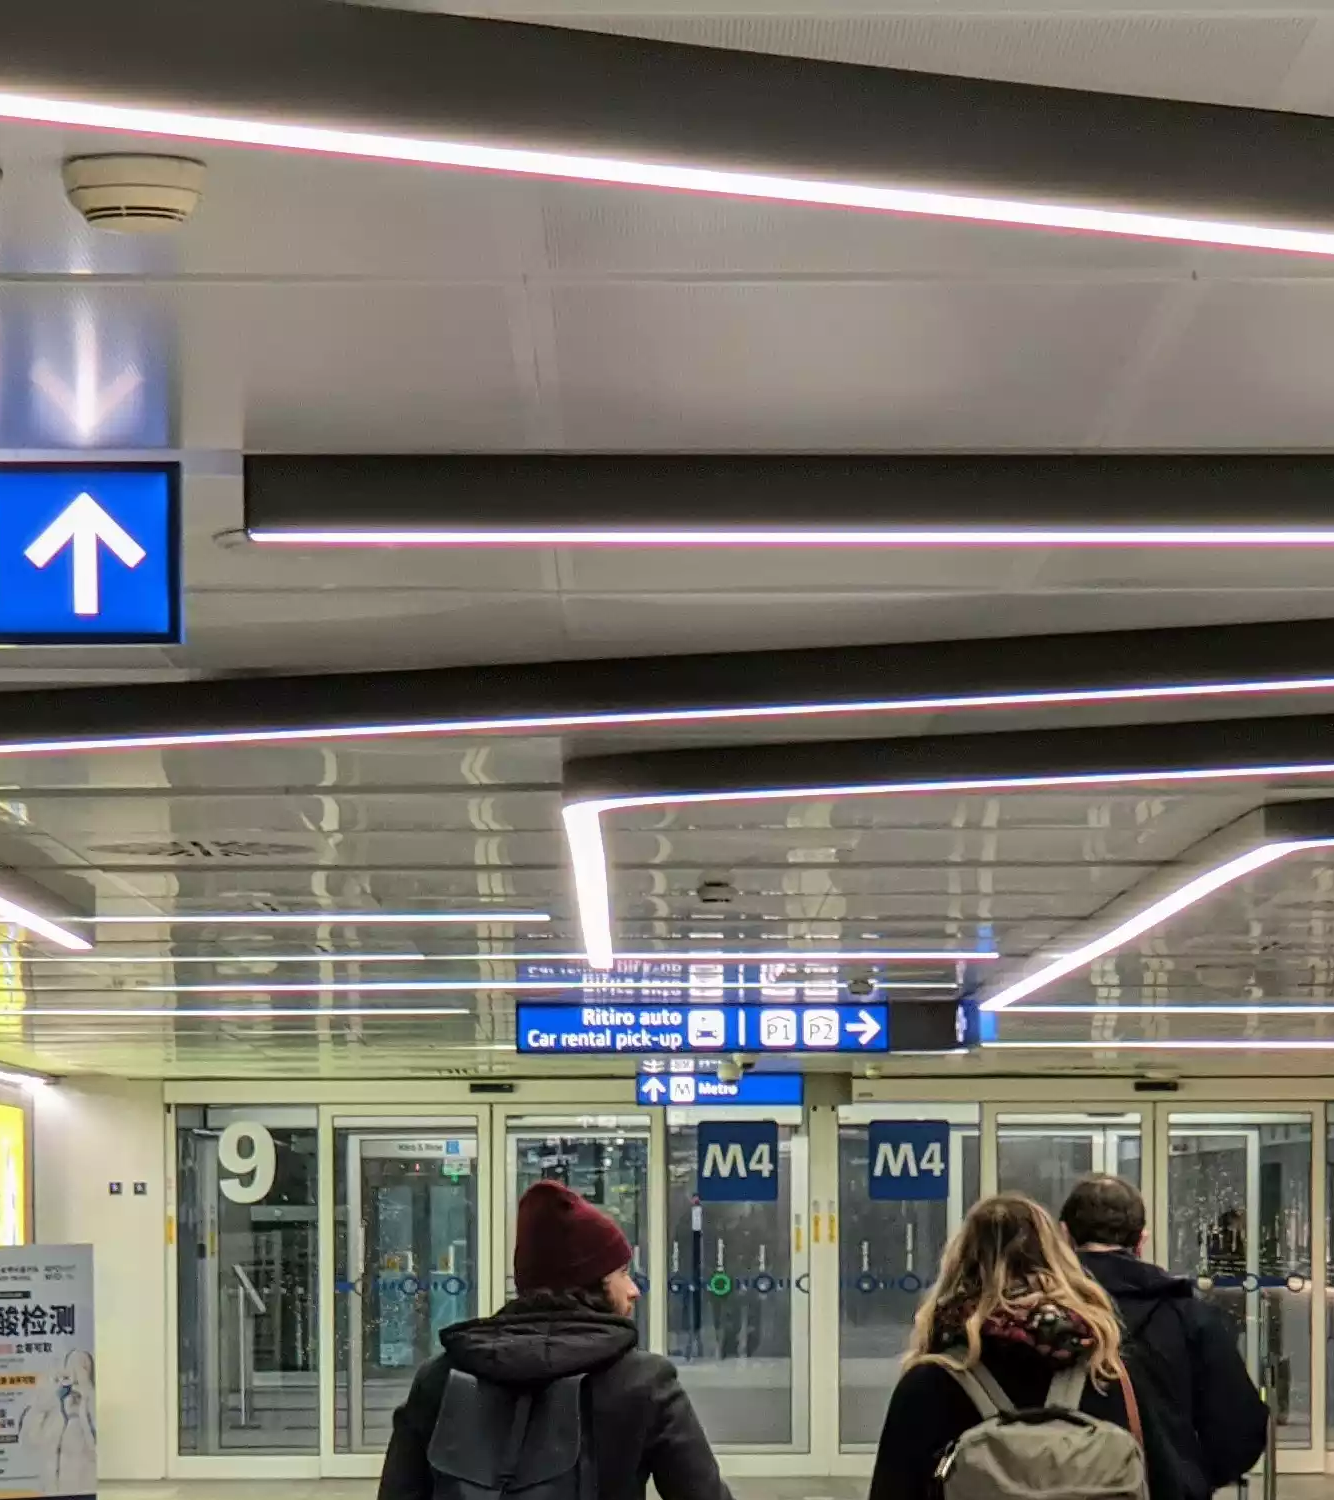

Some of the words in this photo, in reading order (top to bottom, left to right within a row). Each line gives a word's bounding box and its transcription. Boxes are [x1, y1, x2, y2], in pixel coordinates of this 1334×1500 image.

[582, 1008, 635, 1026] Ritiro
[640, 1010, 682, 1026] auto
[527, 1029, 557, 1048] Car
[561, 1029, 612, 1048] rental
[616, 1029, 682, 1053] pick-up
[767, 1023, 791, 1041] P1
[809, 1023, 833, 1041] P2
[697, 1083, 739, 1097] Metro
[217, 1120, 277, 1205] 9
[701, 1143, 774, 1179] M4
[872, 1142, 945, 1178] M4
